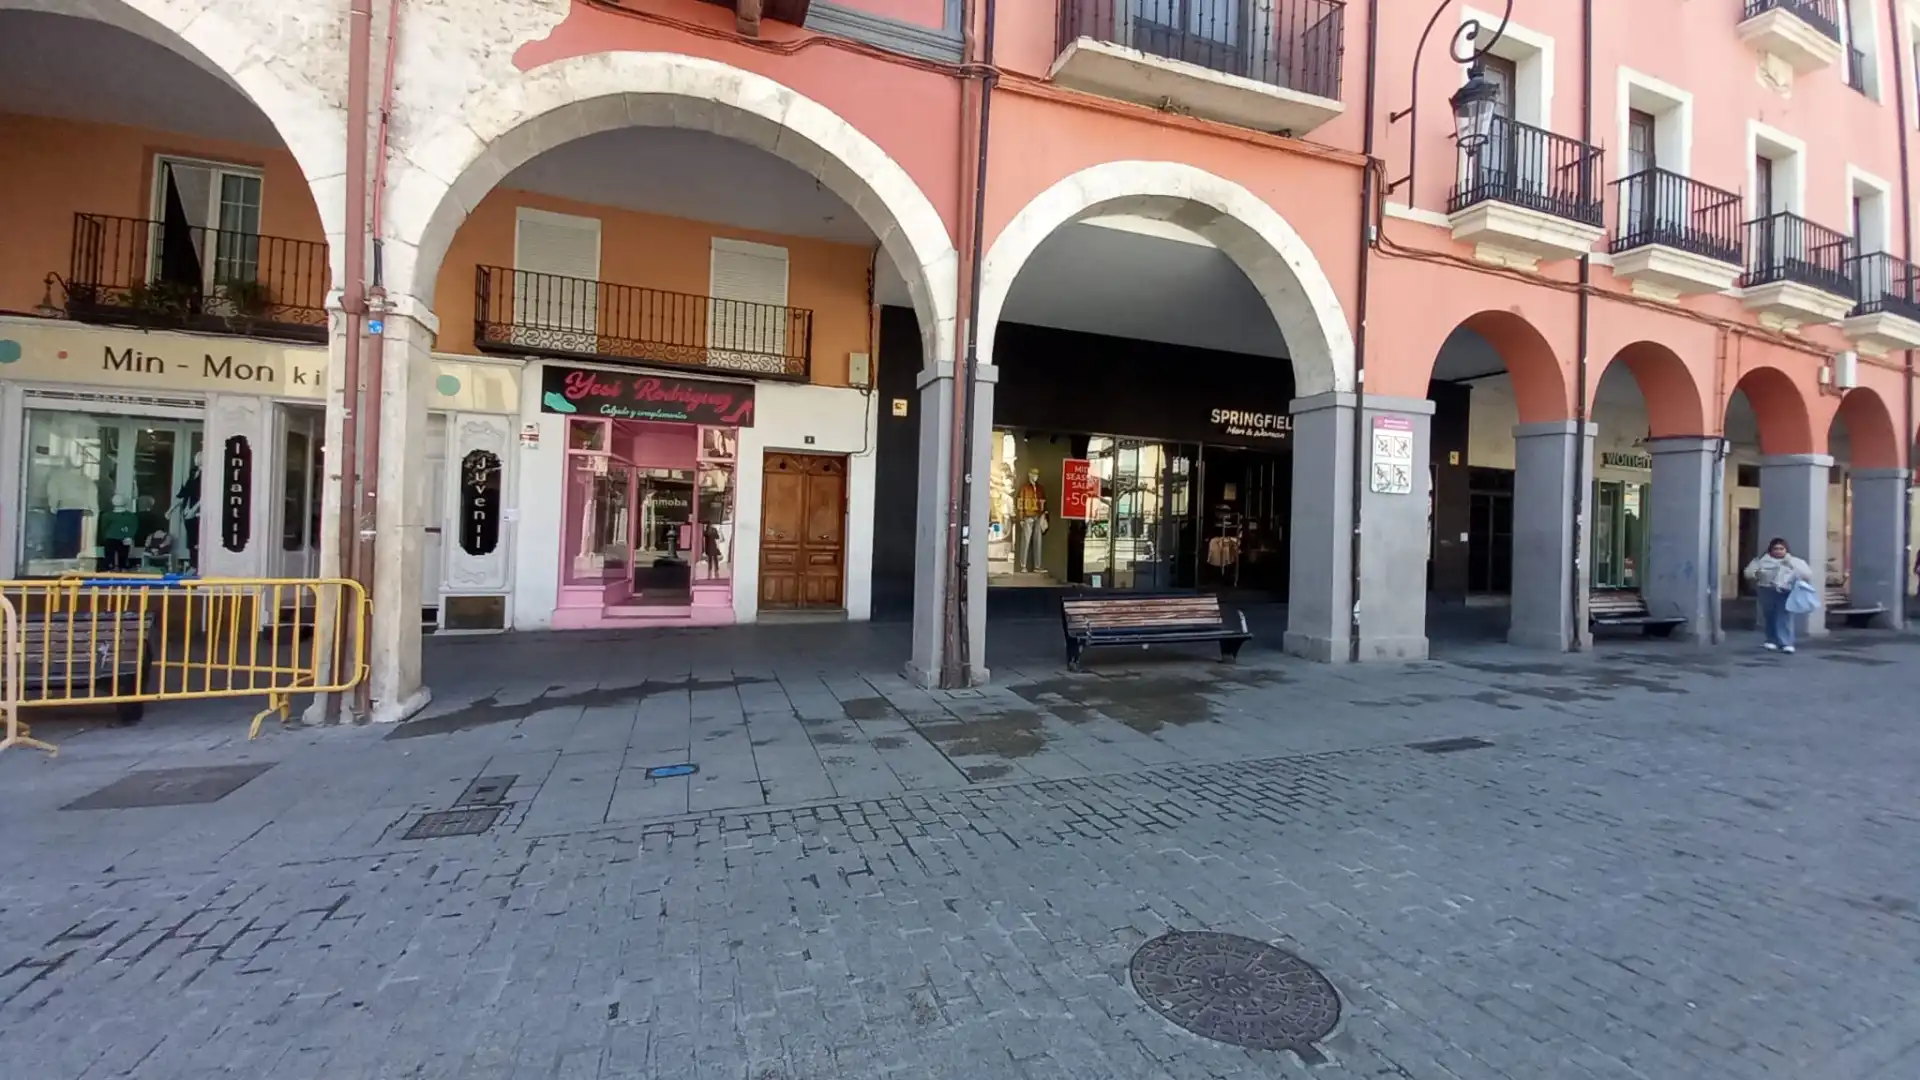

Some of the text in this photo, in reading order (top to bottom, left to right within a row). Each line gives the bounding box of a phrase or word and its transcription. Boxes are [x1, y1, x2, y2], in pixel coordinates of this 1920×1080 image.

[102, 346, 164, 373] Min
[203, 354, 274, 382] Mon
[1210, 408, 1293, 430] SPRINGFIEL
[230, 442, 243, 546] Infantil
[474, 456, 487, 549] Juvenil
